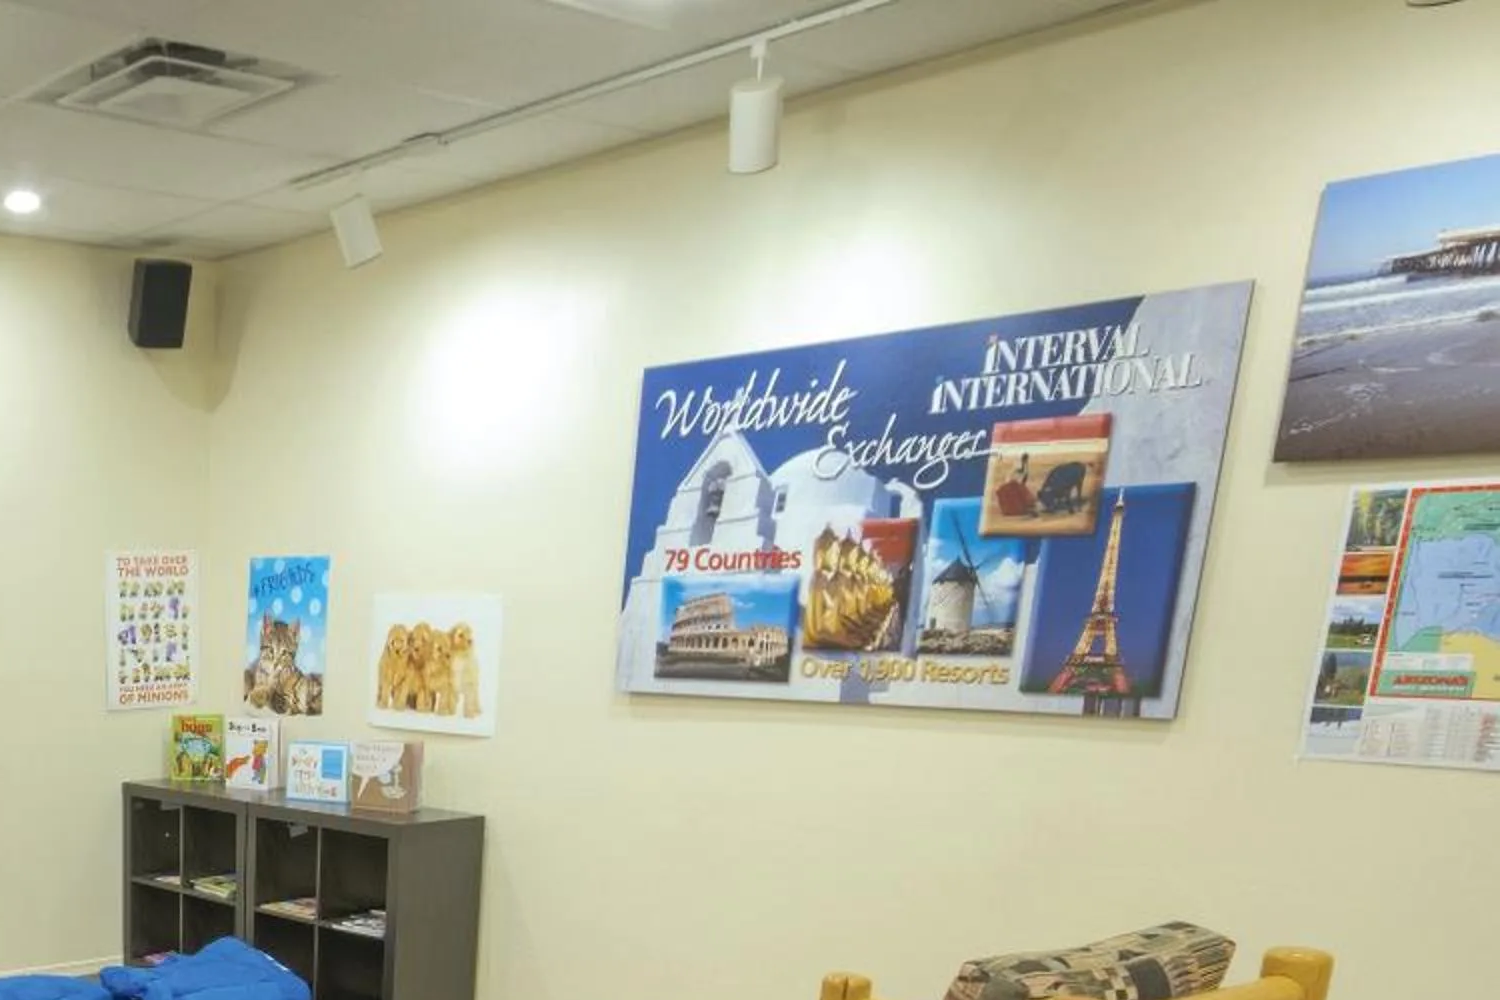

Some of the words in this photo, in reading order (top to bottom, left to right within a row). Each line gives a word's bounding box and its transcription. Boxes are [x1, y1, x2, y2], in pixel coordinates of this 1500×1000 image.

[655, 358, 859, 440] Worldwide
[811, 411, 1003, 490] Exchanges
[116, 566, 140, 577] THE
[145, 564, 189, 577] WORLD
[664, 549, 690, 572] 79
[694, 545, 803, 571] Countries
[802, 657, 853, 680] Over
[920, 660, 1010, 685] Resorts
